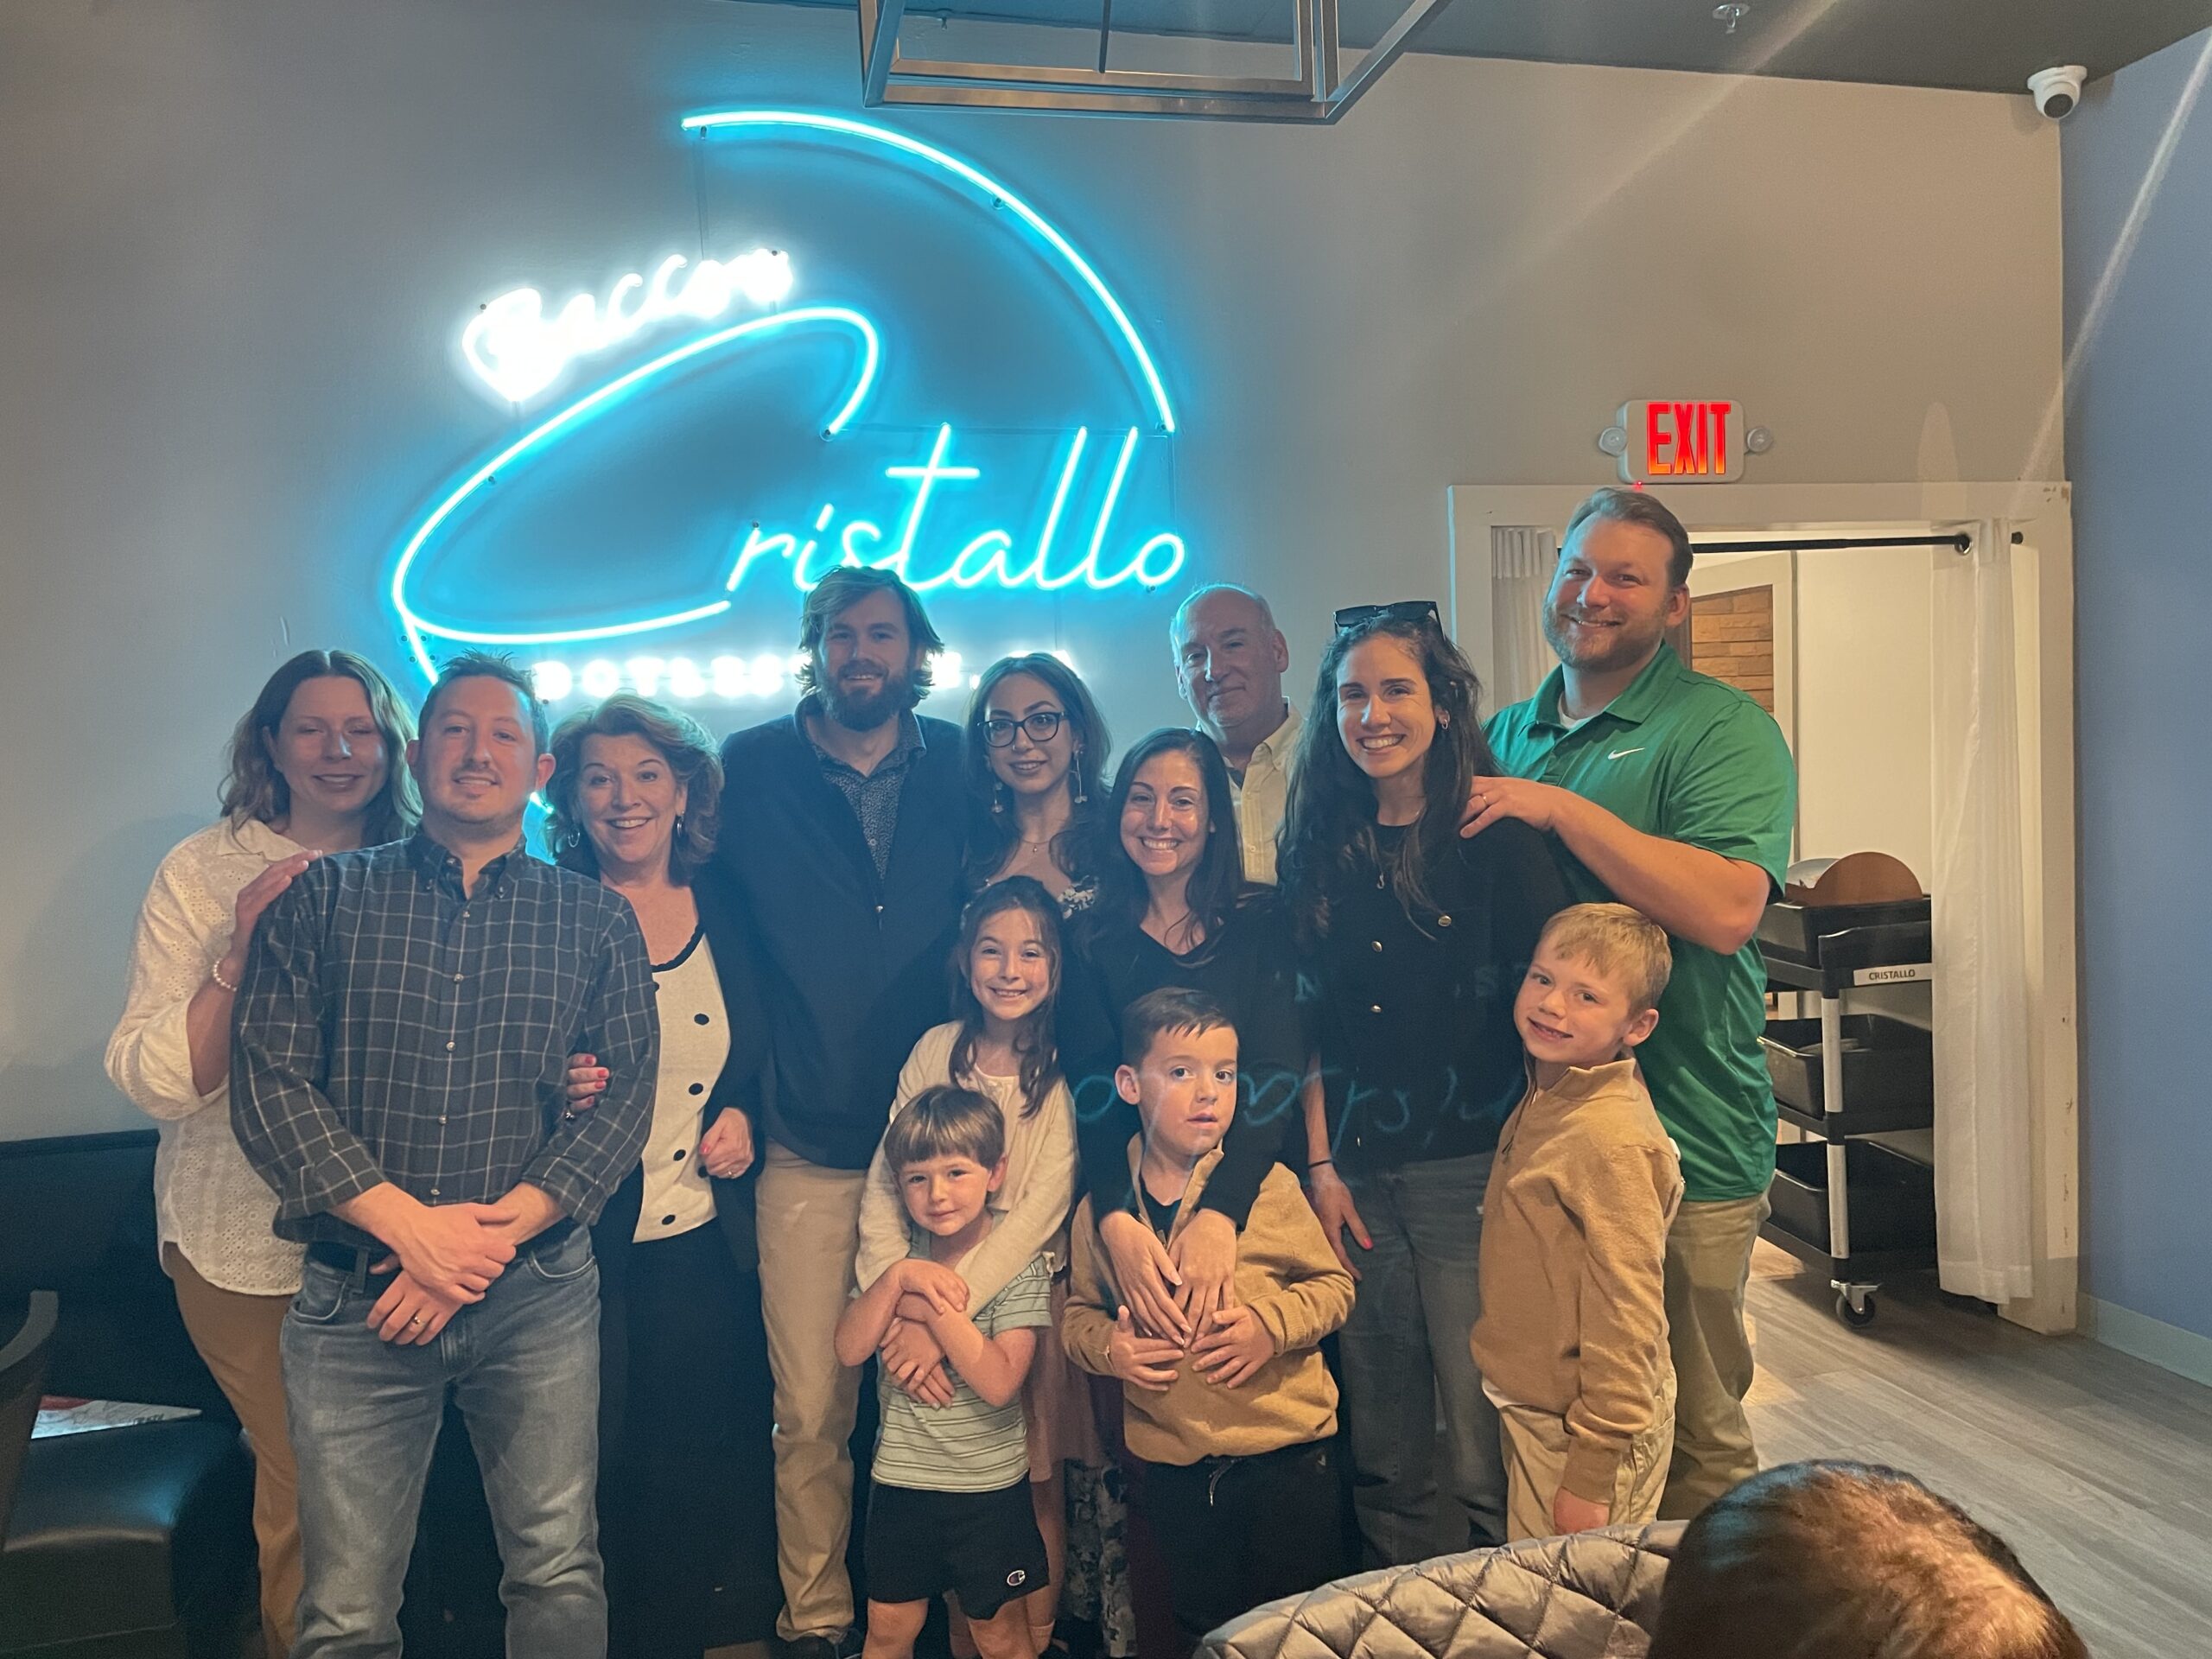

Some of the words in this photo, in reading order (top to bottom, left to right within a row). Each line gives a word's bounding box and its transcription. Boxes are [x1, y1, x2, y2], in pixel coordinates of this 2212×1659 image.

[393, 305, 1185, 643] Cristallo
[1646, 401, 1732, 475] EXIT
[1868, 969, 1916, 981] CRISTALLO
